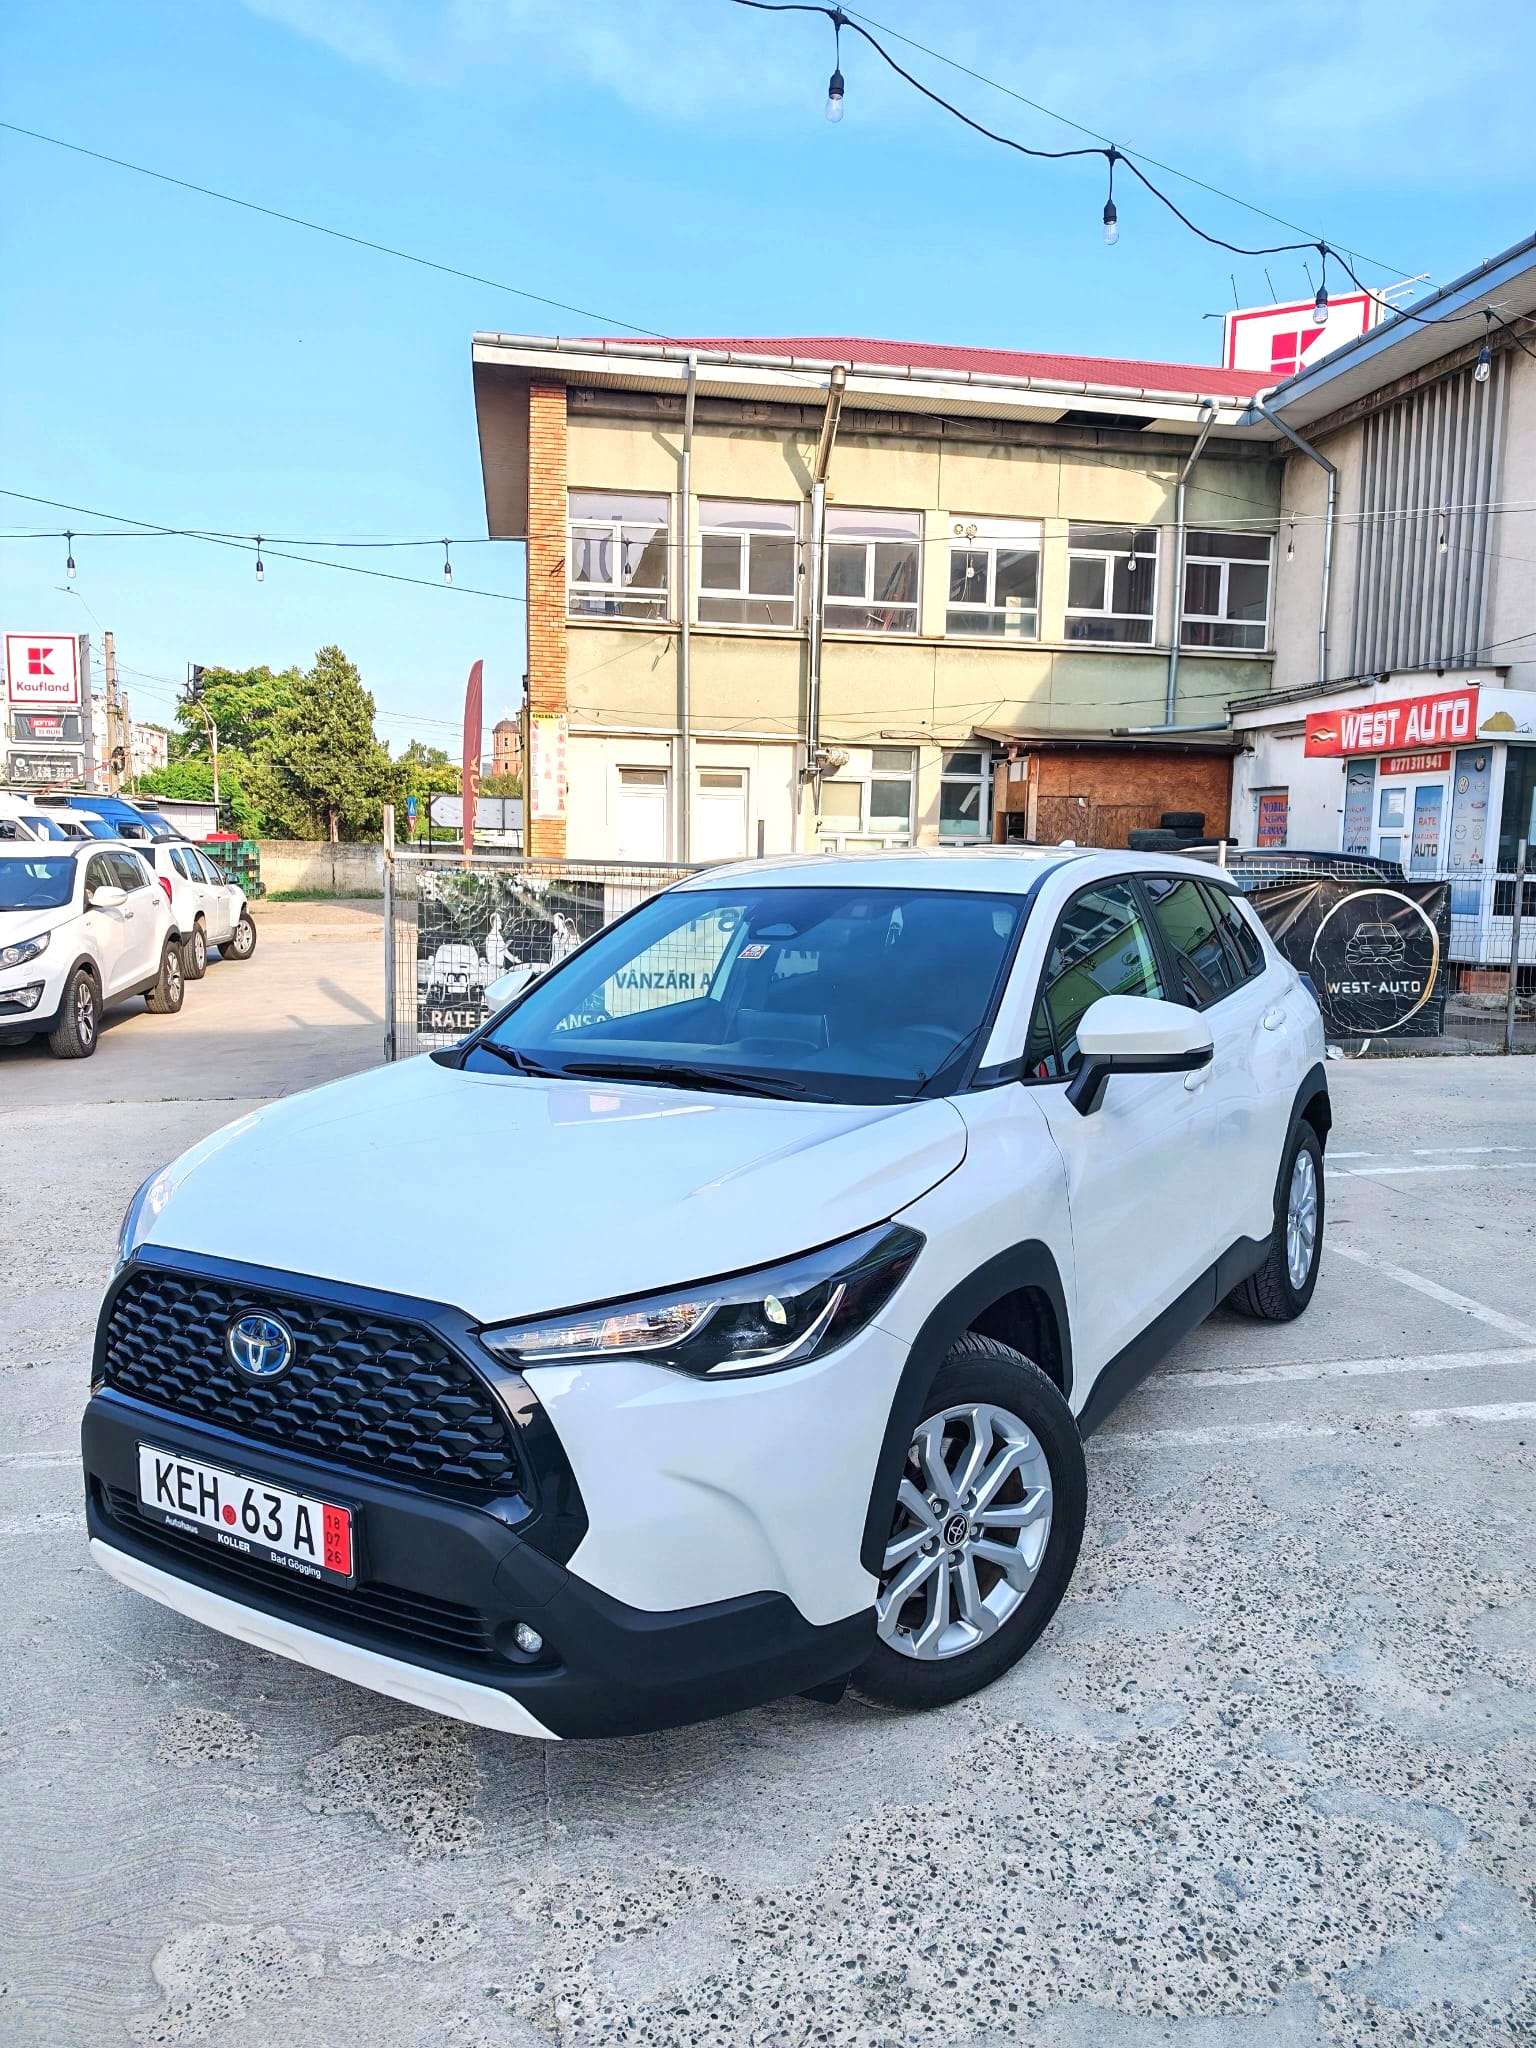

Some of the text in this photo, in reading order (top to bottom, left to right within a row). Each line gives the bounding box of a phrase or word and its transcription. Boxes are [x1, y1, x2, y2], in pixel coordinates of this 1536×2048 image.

[16, 681, 70, 692] Kaufland
[1341, 698, 1470, 749] WEST AUTO
[1418, 817, 1437, 825] RATE
[1413, 843, 1438, 857] AUTO
[615, 969, 695, 989] VÂNZĂRI
[1327, 980, 1421, 994] WEST-AUTO
[430, 1010, 476, 1029] RATE
[155, 1457, 316, 1557] KEH 63 A
[165, 1515, 199, 1535] Autohaus
[326, 1514, 340, 1530] 18
[217, 1532, 251, 1553] KOLLER
[326, 1531, 341, 1547] 07
[270, 1551, 322, 1580] Bad Gögging
[327, 1548, 342, 1565] 26
